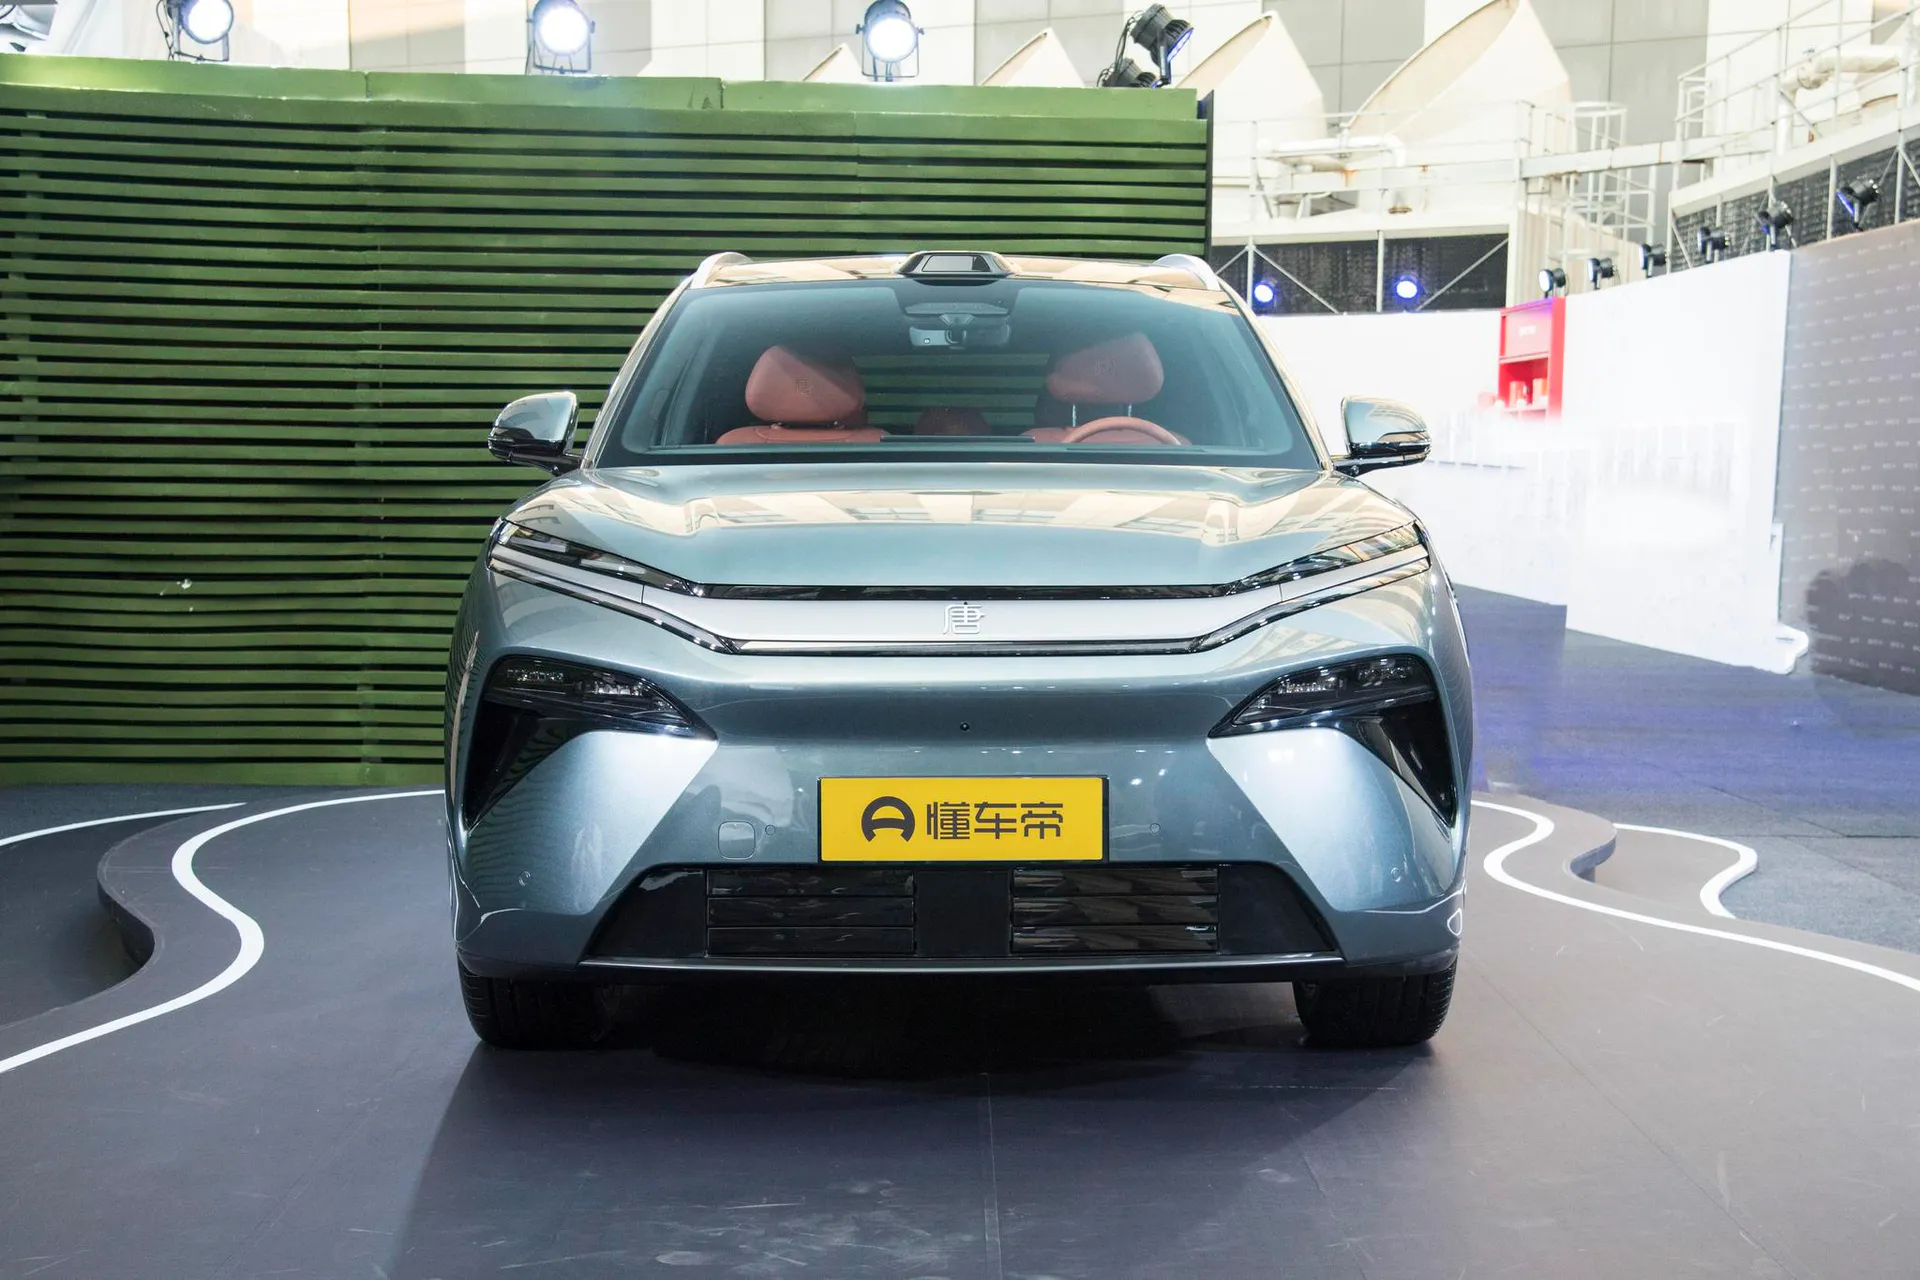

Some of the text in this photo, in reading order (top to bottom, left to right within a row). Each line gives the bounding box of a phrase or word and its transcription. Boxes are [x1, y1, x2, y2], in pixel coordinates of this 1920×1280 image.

[943, 602, 986, 635] 唐
[926, 801, 1063, 840] 懂车帝
